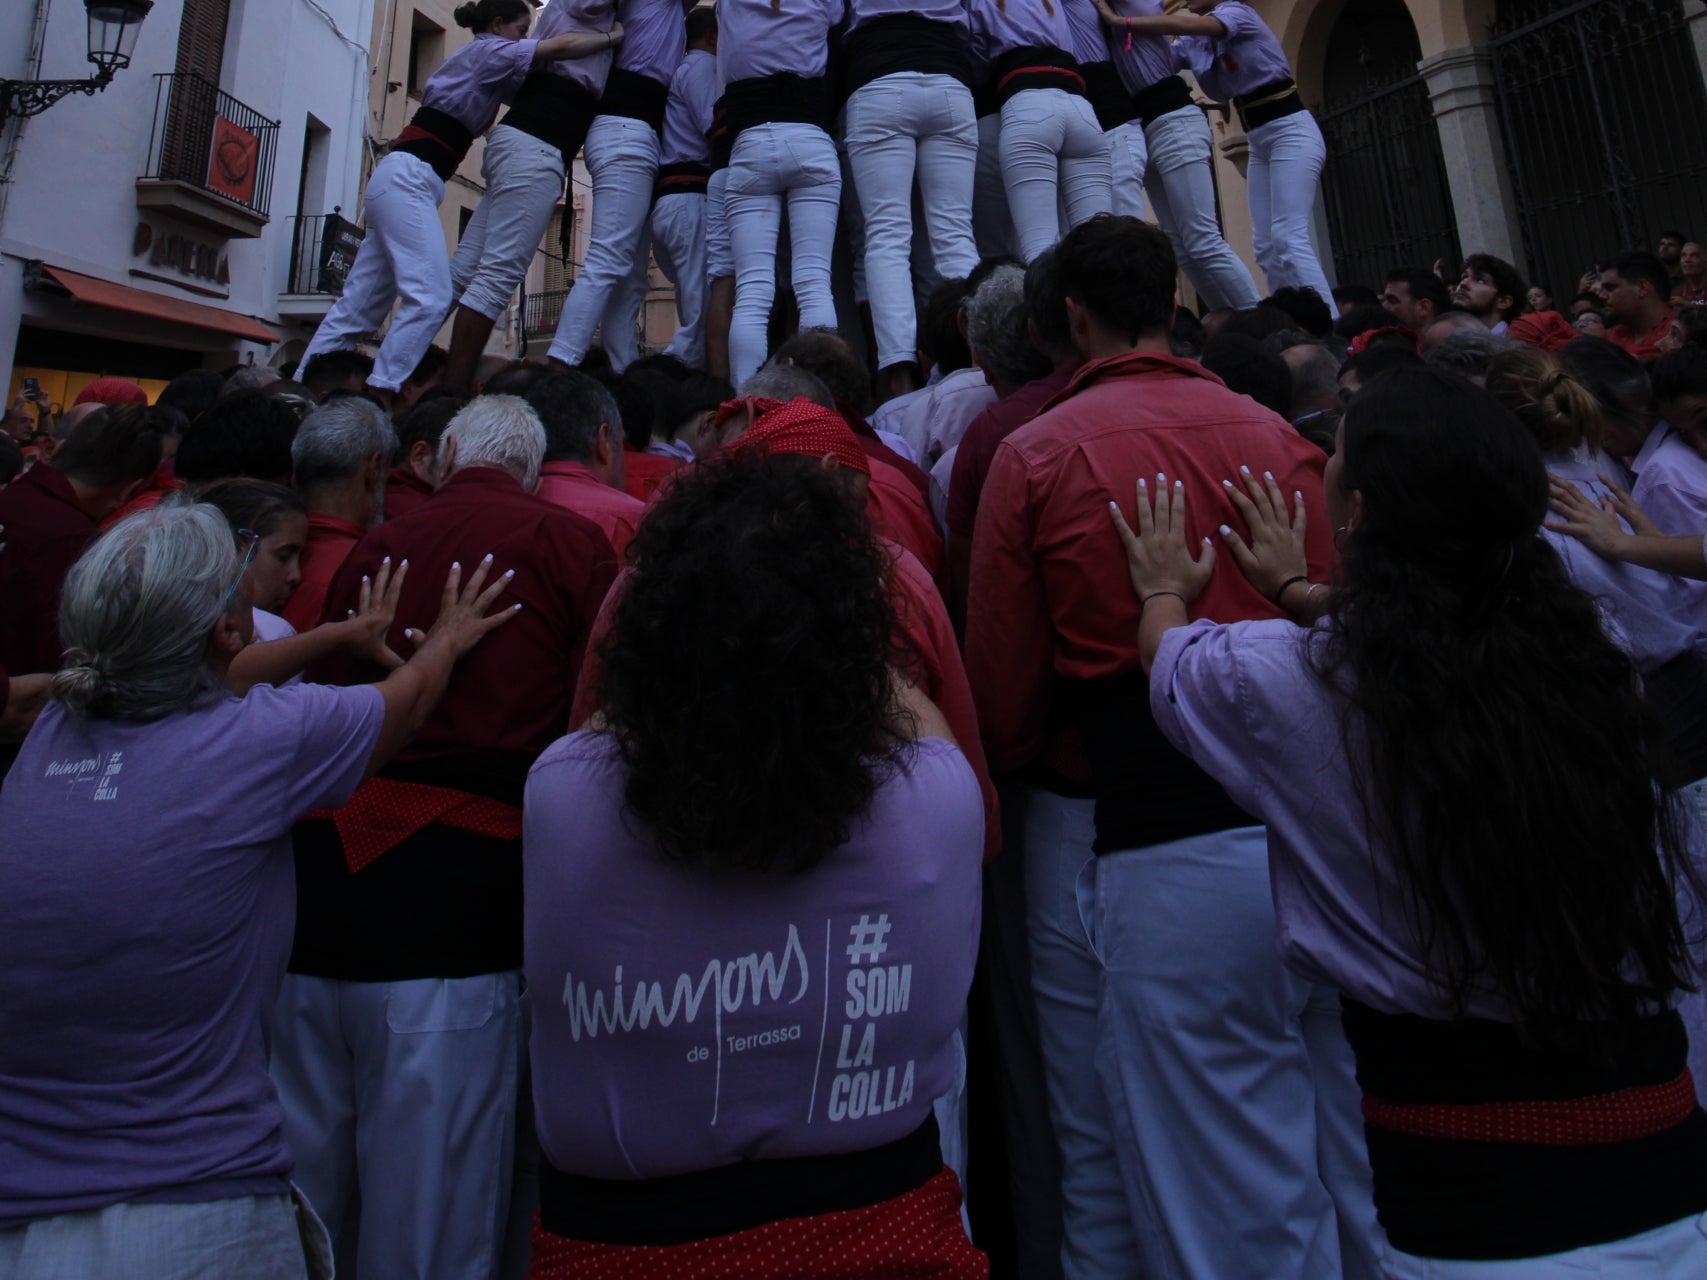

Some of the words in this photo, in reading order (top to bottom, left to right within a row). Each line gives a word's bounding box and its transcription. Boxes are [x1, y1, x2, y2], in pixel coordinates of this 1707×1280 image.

[93, 787, 118, 801] COLLA
[98, 776, 111, 787] LA
[846, 914, 892, 964] #
[846, 964, 913, 1020] SOM
[563, 923, 809, 1127] minyons
[686, 1045, 711, 1064] de
[726, 1024, 802, 1054] Terrassa
[836, 1022, 876, 1070] LA
[827, 1060, 915, 1123] COLLA
